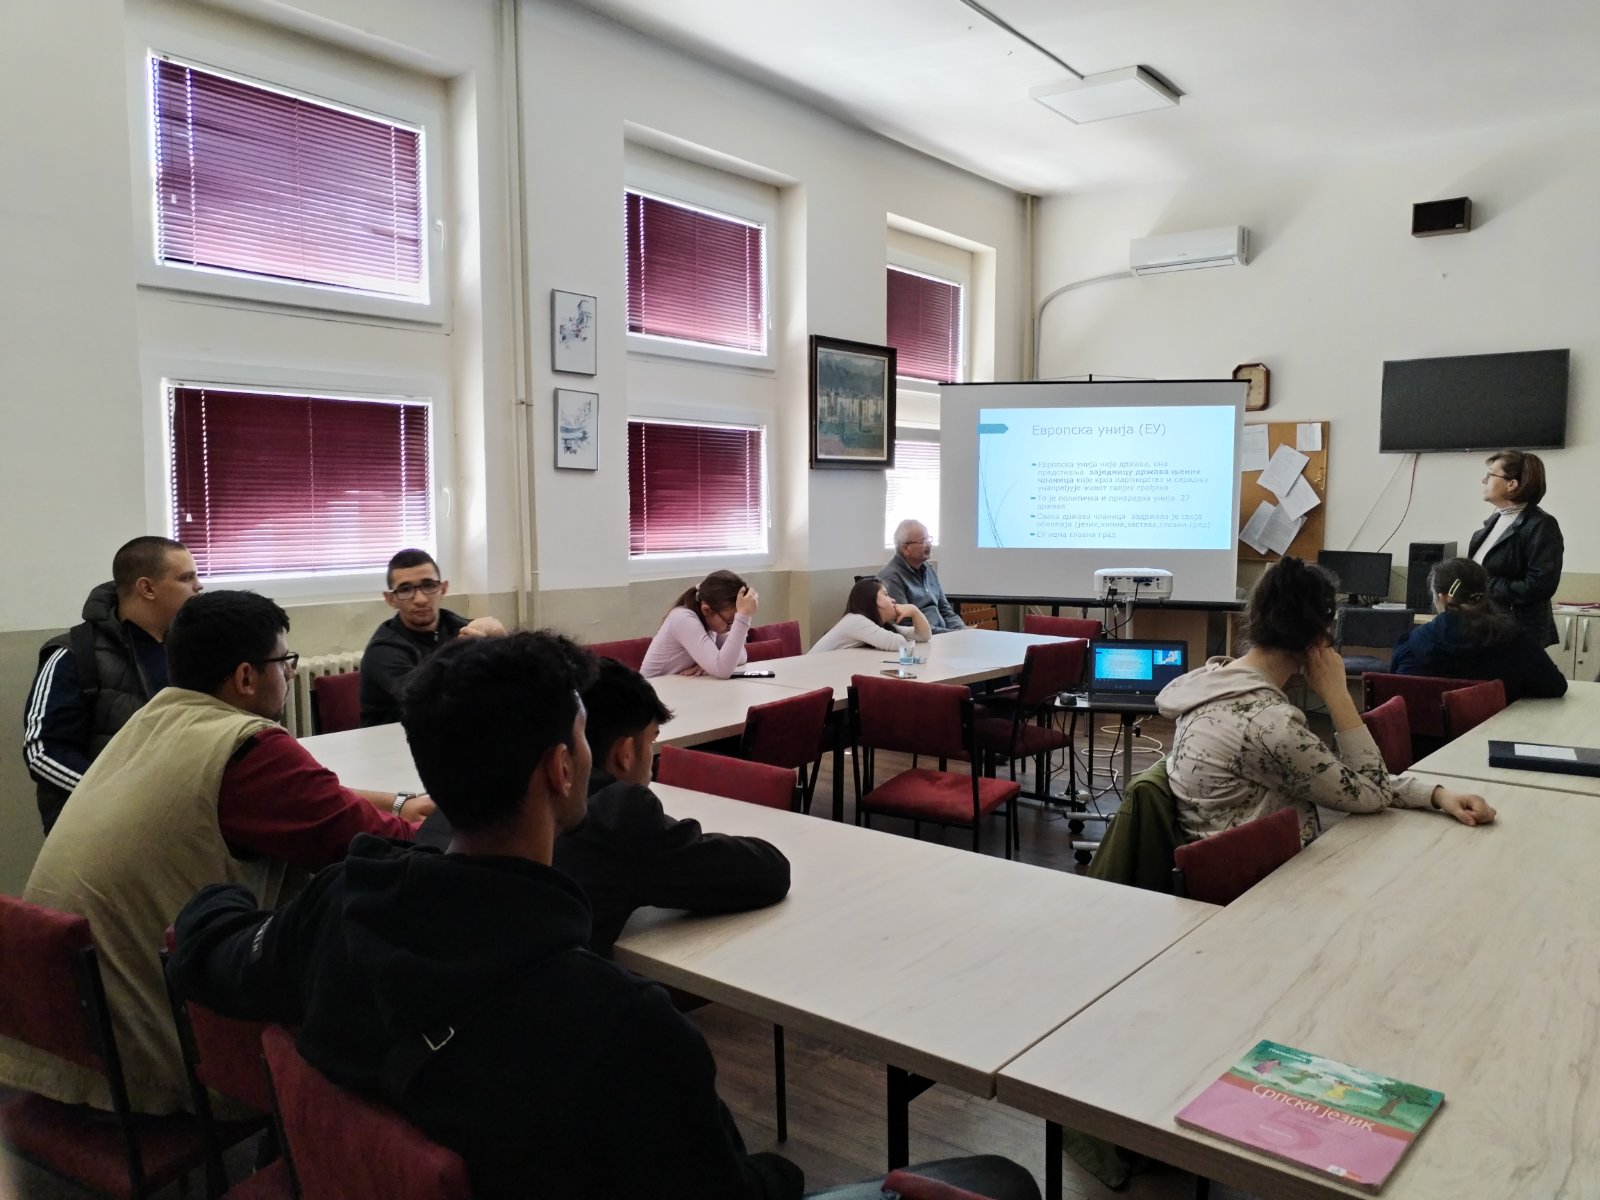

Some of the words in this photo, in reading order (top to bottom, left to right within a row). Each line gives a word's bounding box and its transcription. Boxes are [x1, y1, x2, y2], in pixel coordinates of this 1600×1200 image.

[1032, 424, 1093, 438] Европска
[1097, 423, 1134, 437] унија
[1139, 423, 1166, 437] (ЕУ)
[1180, 494, 1191, 502] 27
[1252, 1084, 1320, 1113] Српски
[1317, 1106, 1376, 1132] језик
